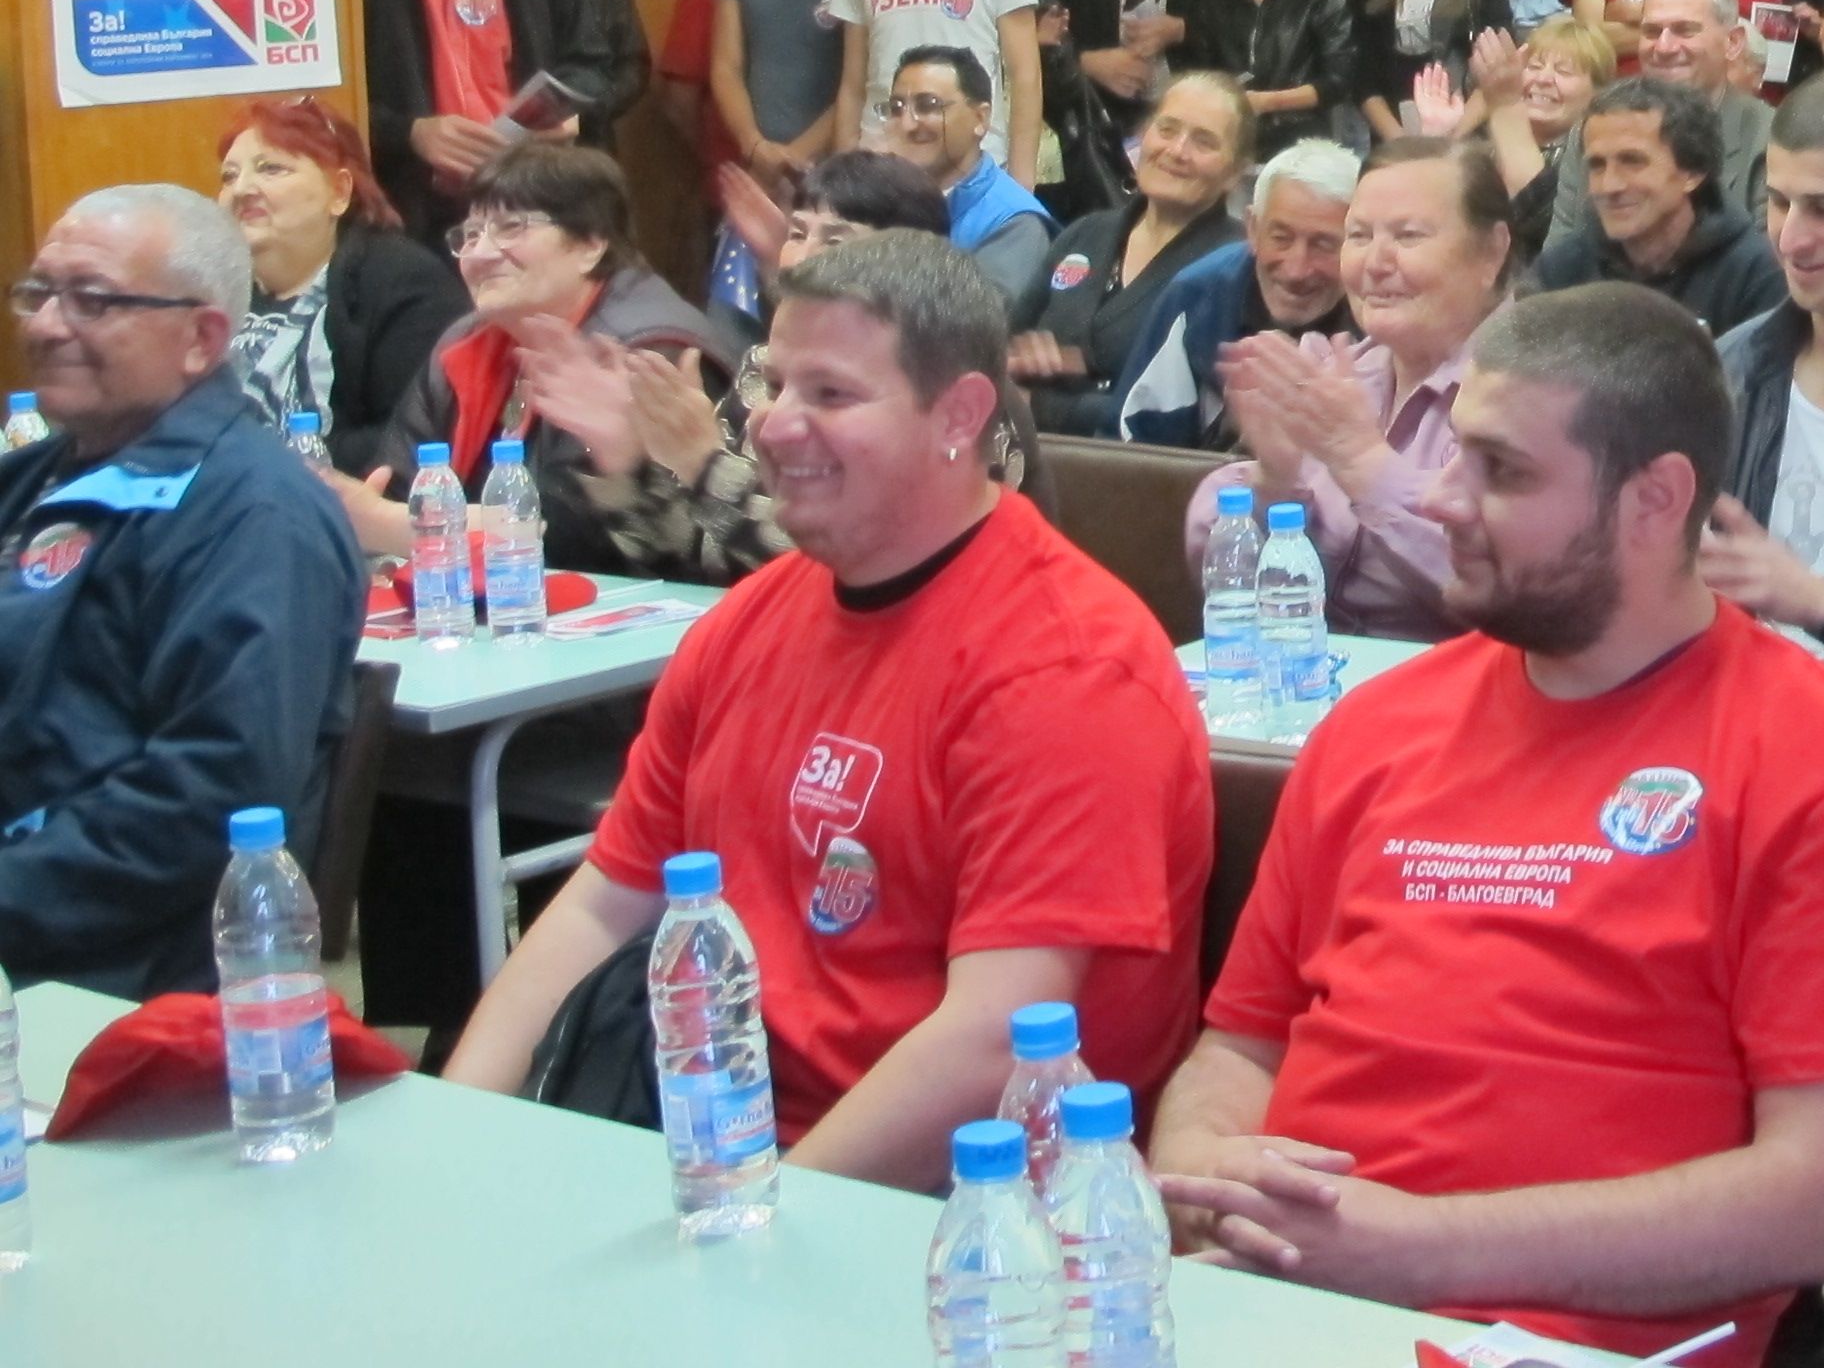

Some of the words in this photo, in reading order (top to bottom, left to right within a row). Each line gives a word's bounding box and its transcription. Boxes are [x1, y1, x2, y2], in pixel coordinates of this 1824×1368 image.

[89, 9, 126, 33] За!
[266, 43, 319, 65] БСП
[801, 745, 857, 792] За!
[1382, 839, 1404, 855] ЗА
[1407, 840, 1522, 862] СПРАВЕДЛИВА
[1524, 844, 1613, 864] БЪЛГАРИЯ
[1401, 860, 1415, 877] И
[1415, 860, 1503, 880] СОЦИАЛНА
[1504, 864, 1572, 884] ЕВРОПА
[1405, 883, 1436, 902] БСП
[1447, 884, 1556, 909] БЛАГОЕВГРАД
